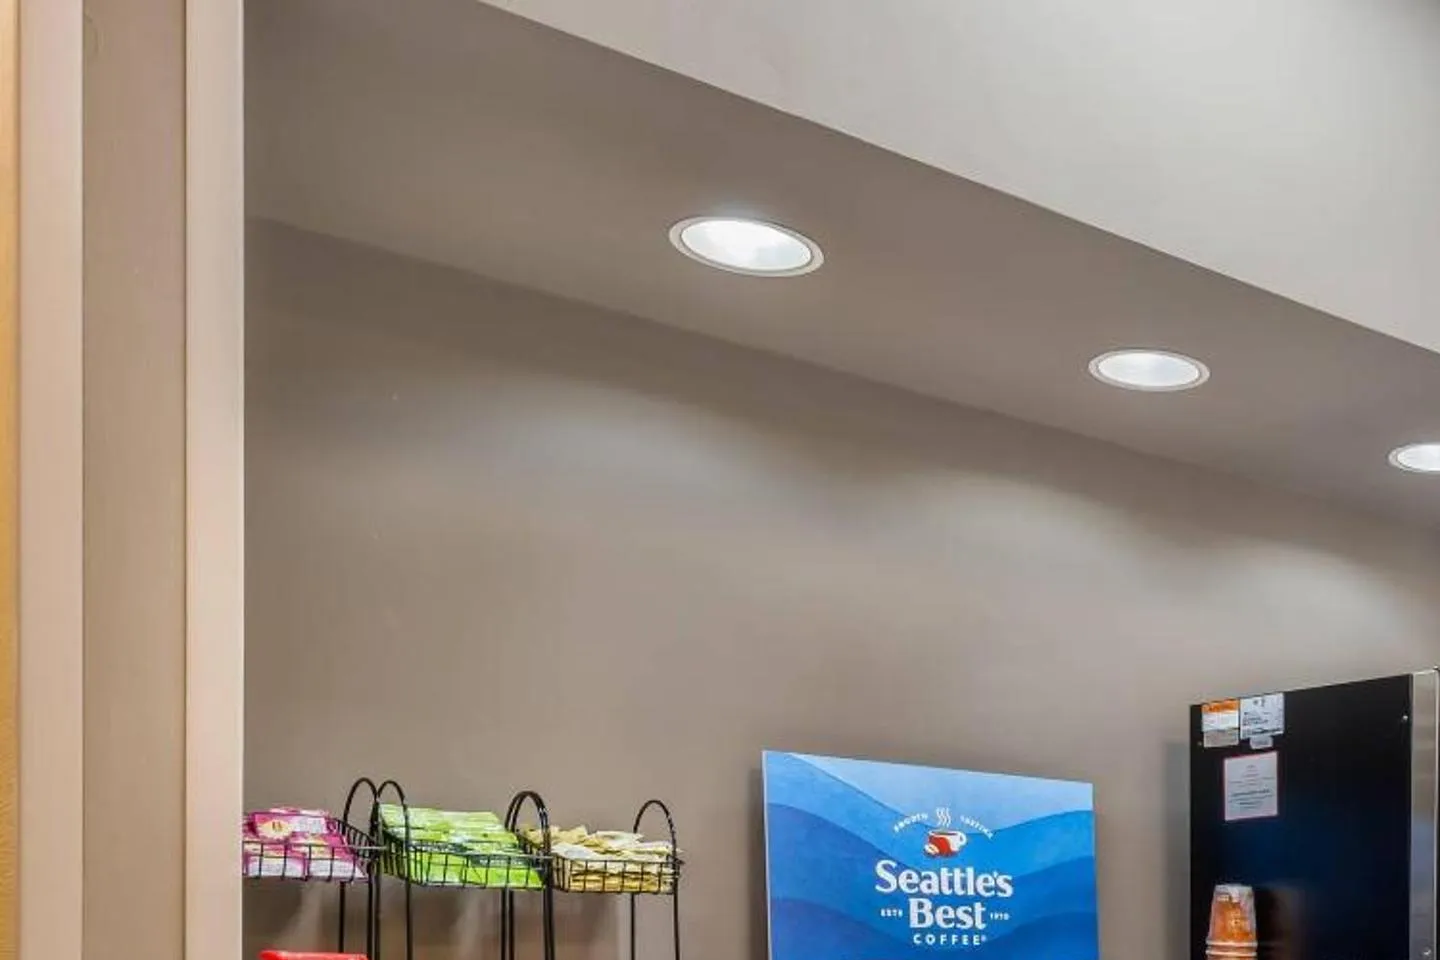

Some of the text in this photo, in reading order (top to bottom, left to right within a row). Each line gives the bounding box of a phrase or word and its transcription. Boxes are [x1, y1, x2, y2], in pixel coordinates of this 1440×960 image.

[874, 859, 1014, 898] Seattle's
[908, 898, 987, 930] Best
[913, 933, 981, 946] COFFEE
